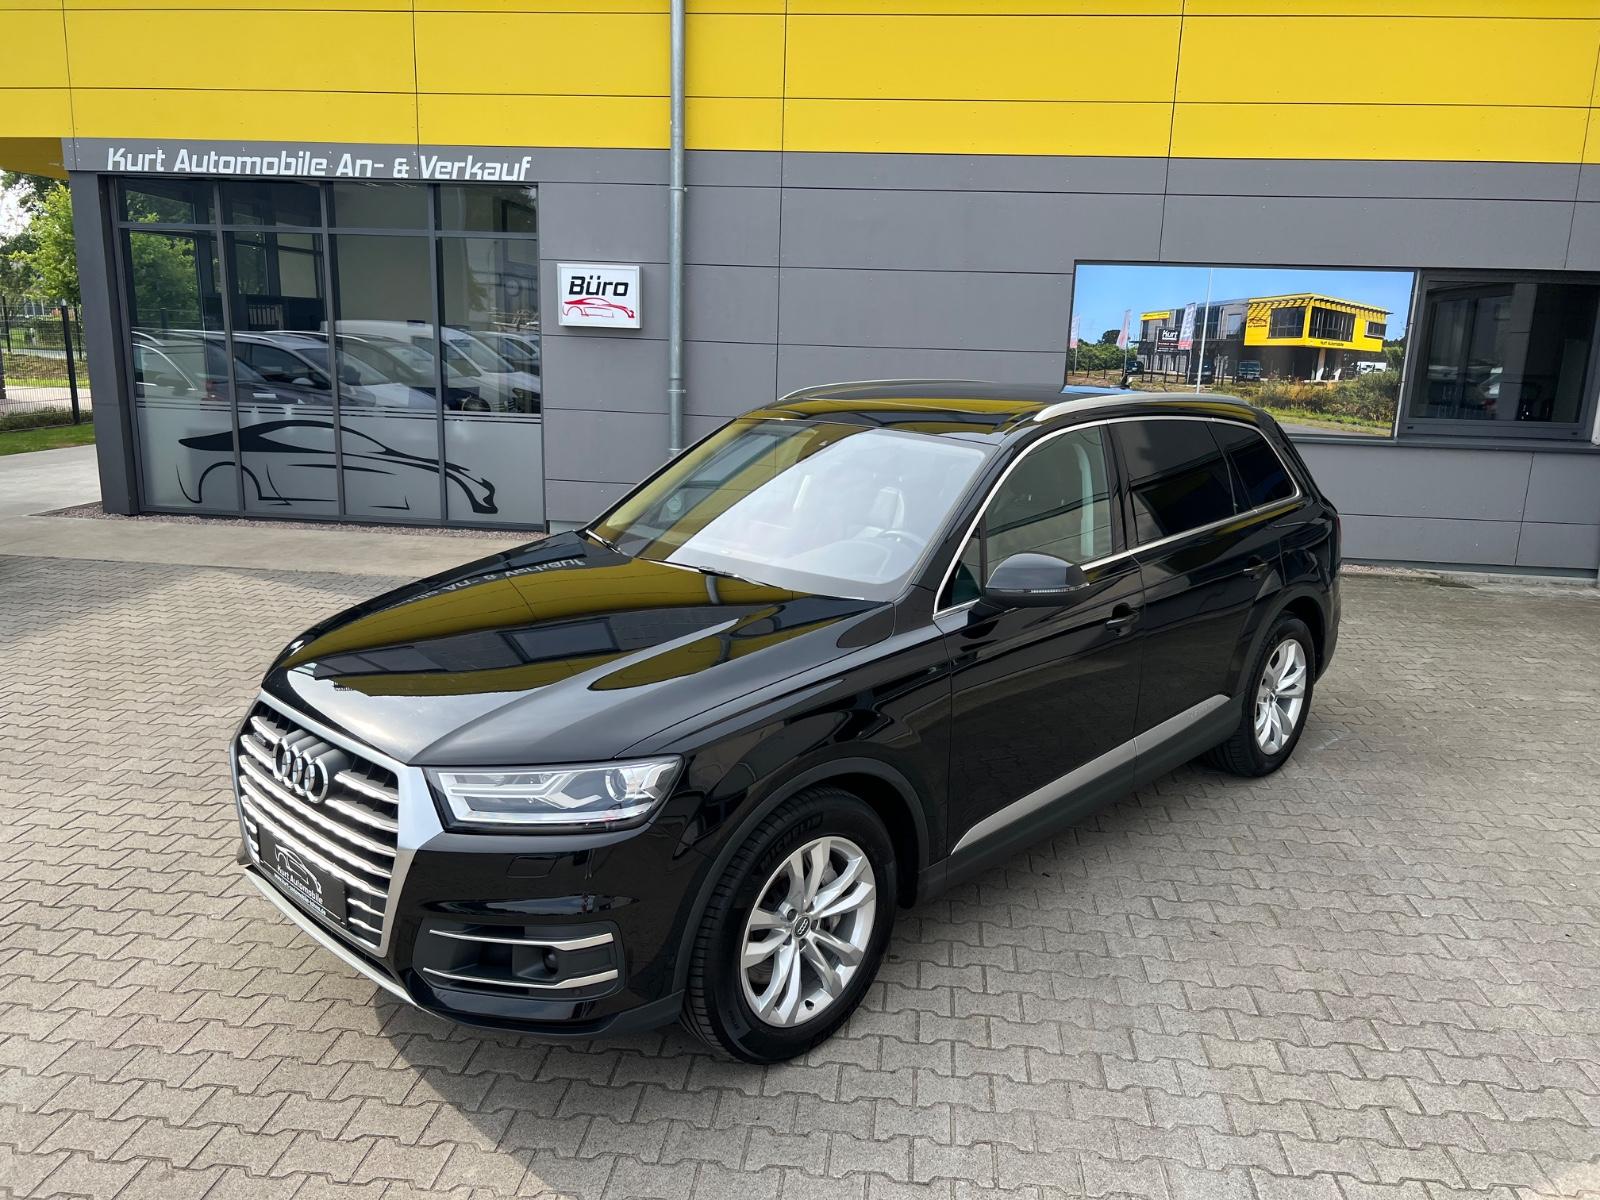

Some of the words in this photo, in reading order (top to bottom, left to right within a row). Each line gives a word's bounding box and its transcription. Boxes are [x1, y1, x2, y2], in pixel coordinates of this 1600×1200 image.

[106, 147, 166, 172] Kurt
[173, 148, 328, 176] Automobile
[336, 153, 385, 177] An-
[393, 158, 409, 179] &
[419, 155, 532, 182] Verkauf
[568, 274, 629, 296] Büro
[1161, 329, 1178, 337] Kurt
[277, 864, 289, 880] Kurt
[290, 874, 324, 905] Automobile
